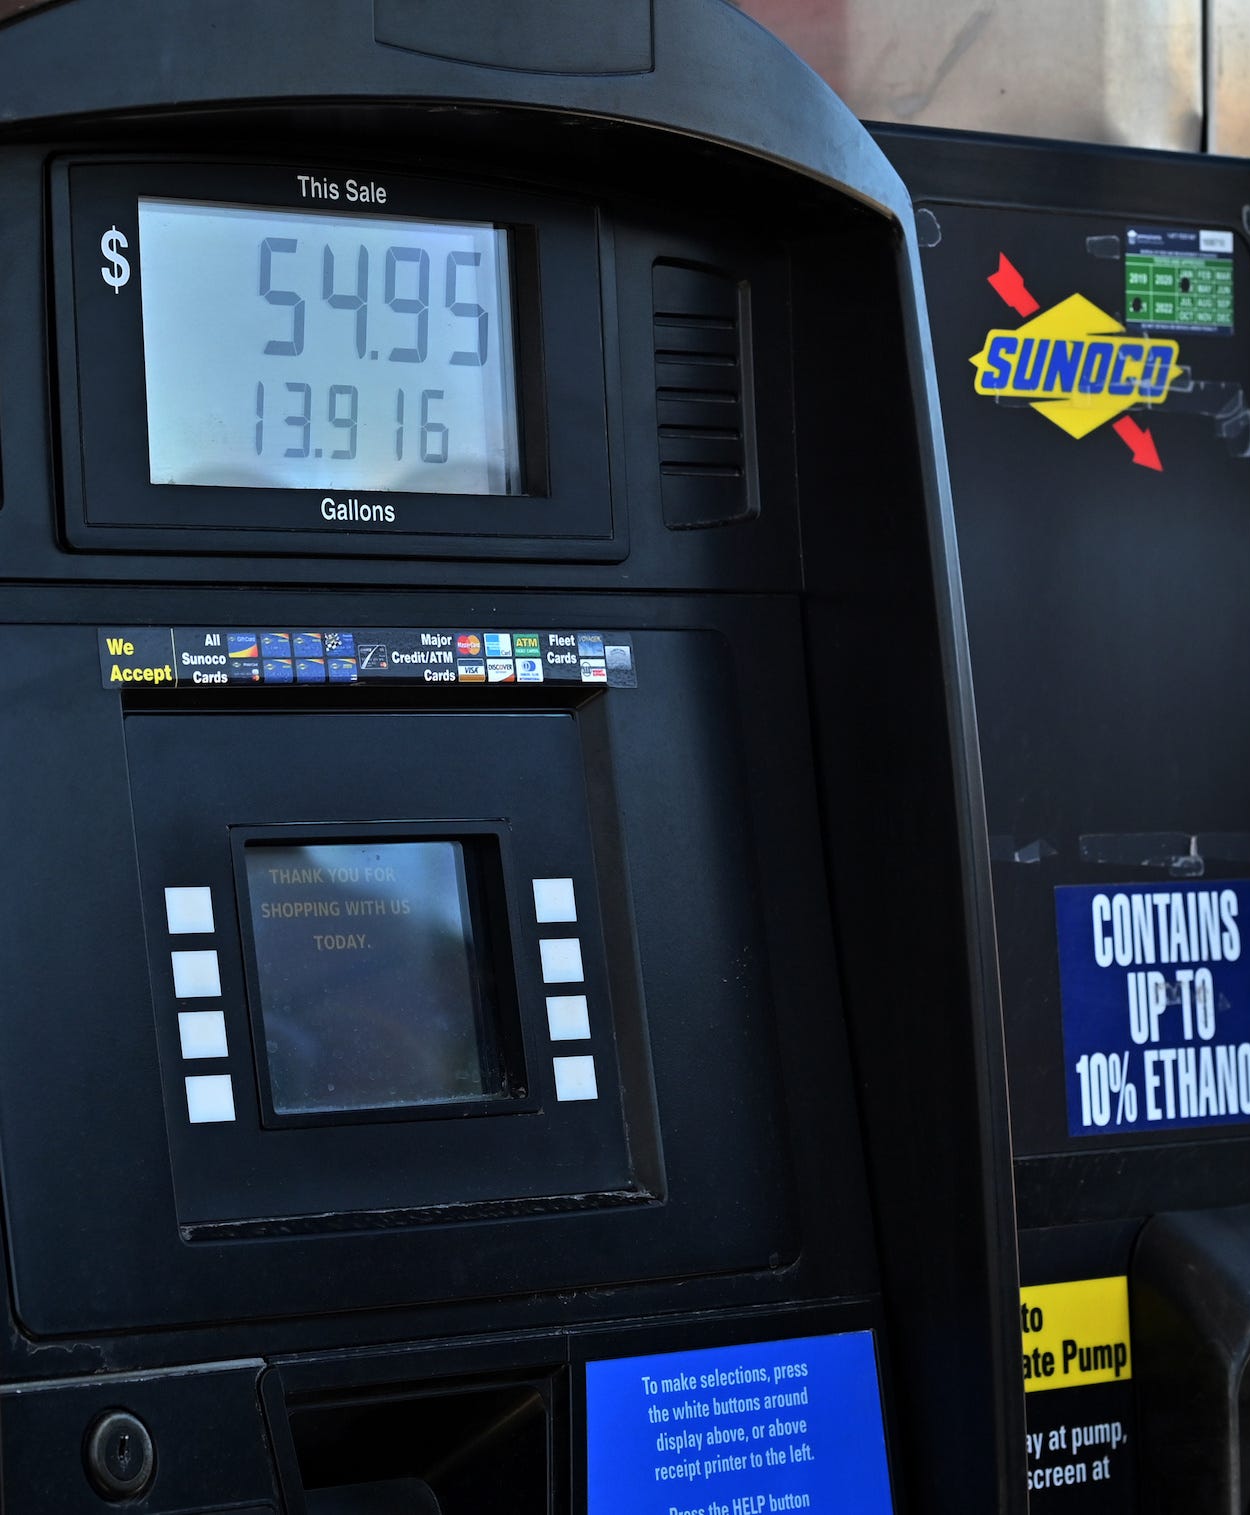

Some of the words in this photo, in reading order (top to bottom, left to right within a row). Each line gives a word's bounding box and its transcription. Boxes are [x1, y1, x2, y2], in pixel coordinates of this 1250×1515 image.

[297, 175, 339, 200] This
[345, 179, 387, 204] Sale
[101, 225, 130, 294] $
[259, 236, 488, 366] 54.95
[980, 336, 1174, 397] SUNOCO
[255, 380, 449, 464] 13.916
[320, 498, 395, 524] Gallons
[106, 638, 134, 656] We
[205, 634, 221, 647] All
[420, 634, 452, 648] Major
[516, 638, 538, 648] ATM
[549, 634, 576, 646] Fleet
[182, 652, 227, 666] Sunoco
[392, 651, 454, 664] Credit/ATM
[488, 664, 513, 672] DISCOVER
[546, 651, 577, 664] Cards
[110, 665, 172, 685] Accept
[192, 671, 228, 684] Cards
[424, 669, 456, 682] Cards
[464, 666, 479, 674] VISA
[269, 868, 324, 884] THANK
[329, 868, 359, 882] YOU
[365, 867, 396, 882] FOR
[261, 902, 340, 918] SHOPPING
[346, 900, 386, 916] WITH
[391, 900, 411, 914] US
[1092, 889, 1241, 968] CONTAINS
[314, 934, 371, 951] TODAY.
[1127, 971, 1166, 1045] UP
[1176, 967, 1216, 1040] TO
[1076, 1051, 1138, 1127] 10%
[1021, 1302, 1043, 1334] to
[1062, 1339, 1128, 1378] Pump
[642, 1376, 658, 1396] To
[661, 1372, 697, 1394] make
[700, 1366, 771, 1389] selections,
[774, 1362, 808, 1384] press
[648, 1404, 670, 1424] the
[672, 1400, 710, 1422] white
[713, 1394, 761, 1416] buttons
[764, 1386, 808, 1410] around
[656, 1429, 702, 1454] display
[706, 1426, 749, 1446] above,
[752, 1422, 765, 1440] or
[768, 1416, 807, 1438] above
[1049, 1425, 1067, 1451] at
[1072, 1421, 1128, 1456] pump,
[655, 1459, 701, 1482] receipt
[704, 1454, 748, 1480] printer
[750, 1451, 763, 1468] to
[766, 1447, 786, 1466] the
[790, 1443, 814, 1462] left.
[1092, 1455, 1111, 1481] at
[708, 1502, 729, 1515] the
[732, 1495, 766, 1515] HELP
[769, 1493, 810, 1512] button
